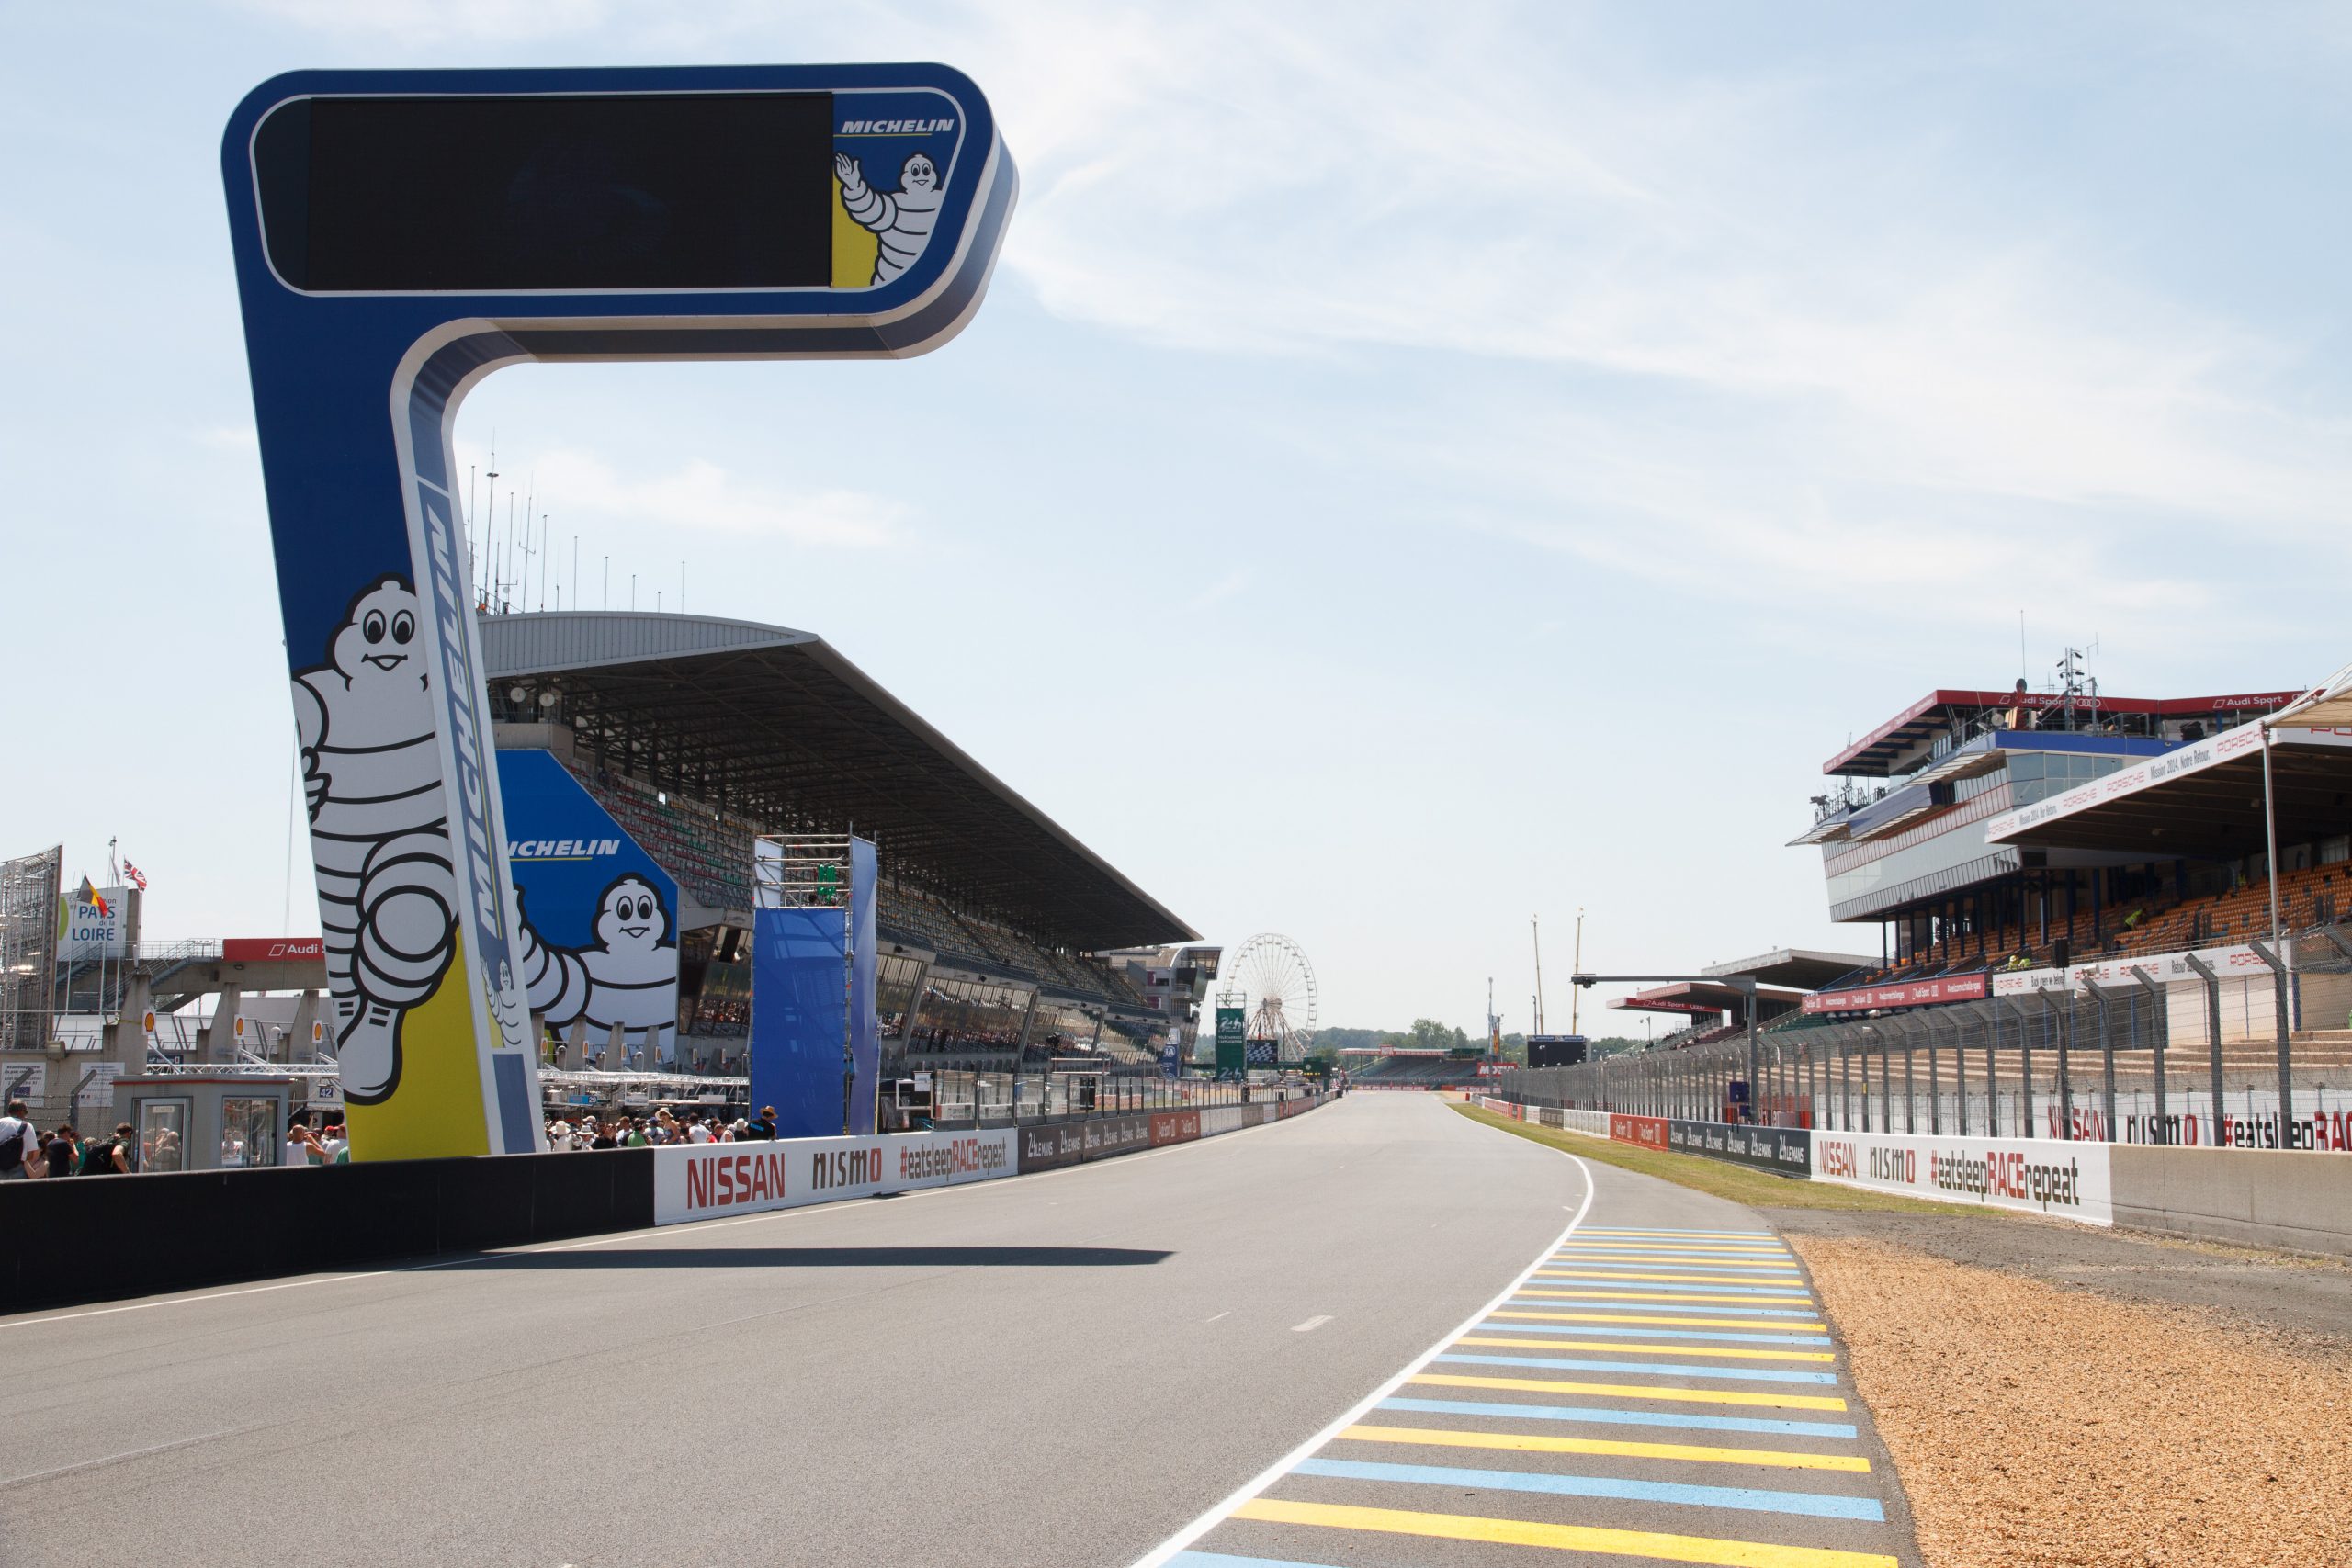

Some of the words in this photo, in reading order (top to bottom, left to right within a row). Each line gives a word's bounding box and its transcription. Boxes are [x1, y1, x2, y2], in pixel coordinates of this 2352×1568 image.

[842, 119, 954, 133] MICHELIN
[2039, 697, 2065, 706] Spor
[2227, 697, 2250, 706] Audi
[2253, 695, 2283, 706] Sport
[426, 502, 497, 937] MICHELIN
[2107, 771, 2145, 792] PORSCHE
[2063, 787, 2098, 808] PORSCHE
[508, 840, 620, 857] ICHELIN
[73, 928, 115, 941] LOIRE
[287, 944, 318, 954] Audi
[2230, 953, 2267, 966] PORS
[1480, 1065, 1516, 1075] MOT
[320, 1088, 332, 1097] 42
[2048, 1105, 2105, 1142] NISAN
[2224, 1111, 2352, 1151] #eatslepRA
[687, 1152, 786, 1210] NISSAN
[899, 1136, 1007, 1182] #eatsleepRACErepeat
[1819, 1140, 1857, 1179] NISSAN
[1930, 1149, 2080, 1212] #eatsleepRACErepeat
